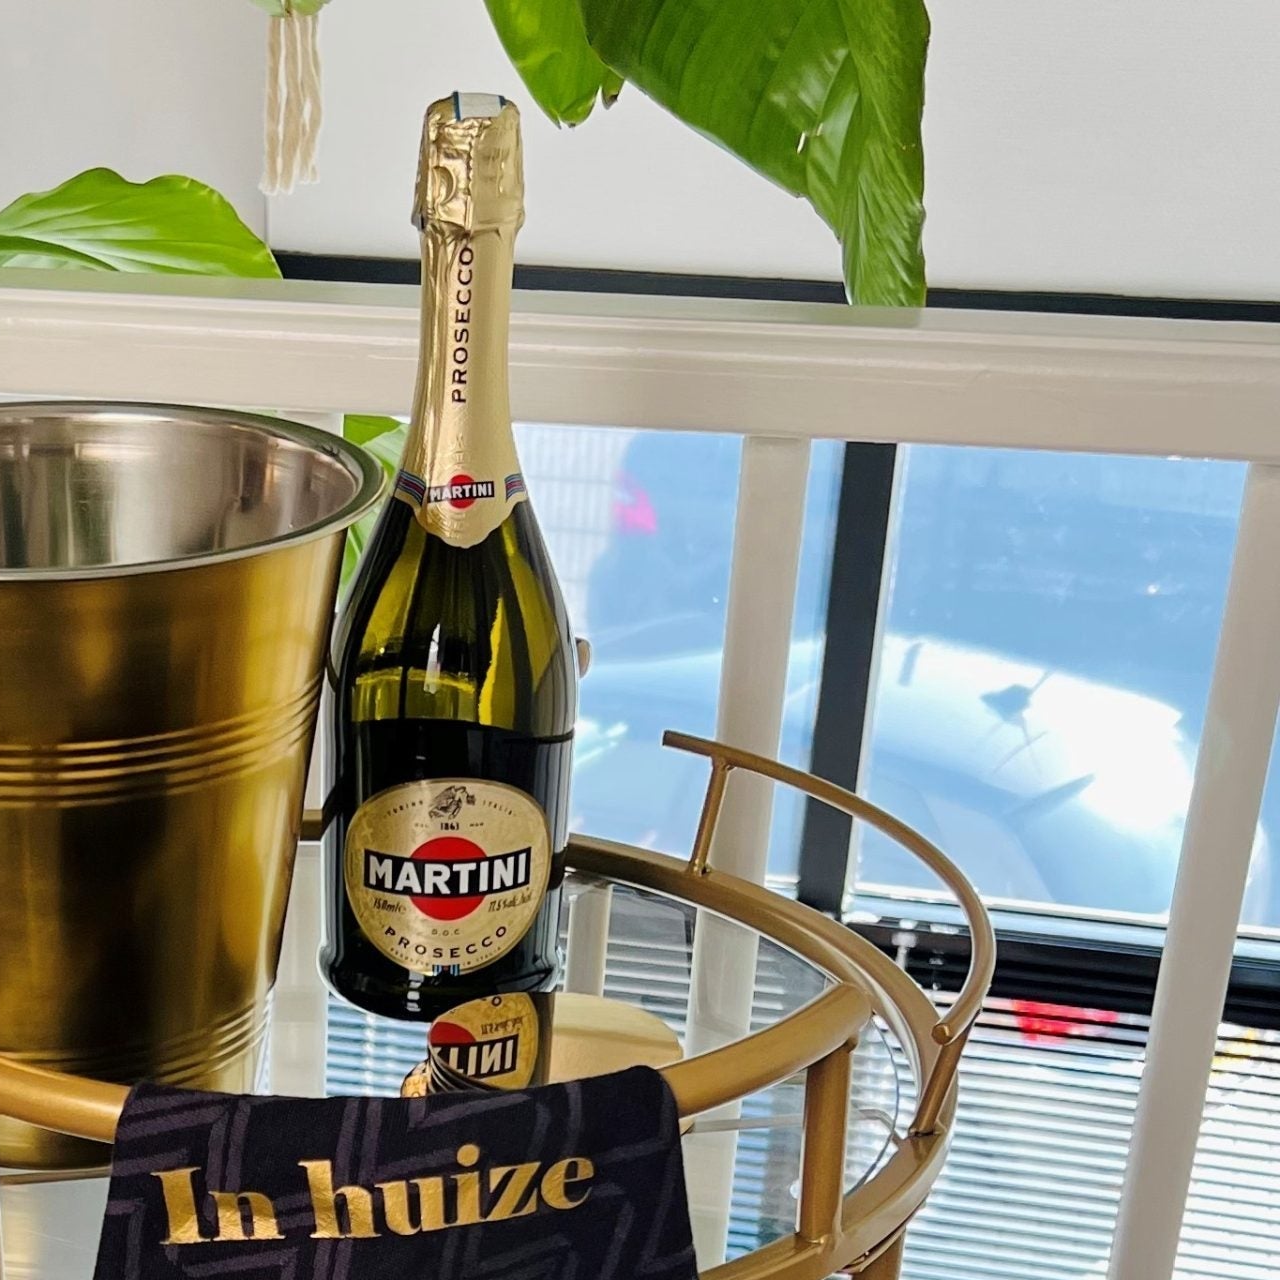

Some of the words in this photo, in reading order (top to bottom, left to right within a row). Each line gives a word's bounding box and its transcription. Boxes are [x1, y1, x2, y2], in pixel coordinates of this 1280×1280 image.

[451, 247, 474, 403] PROSECCO
[429, 483, 493, 502] MARTINI
[369, 852, 527, 894] MARTINI
[384, 925, 507, 959] PROSECCO
[151, 1166, 286, 1245] In
[298, 1144, 594, 1240] huize
